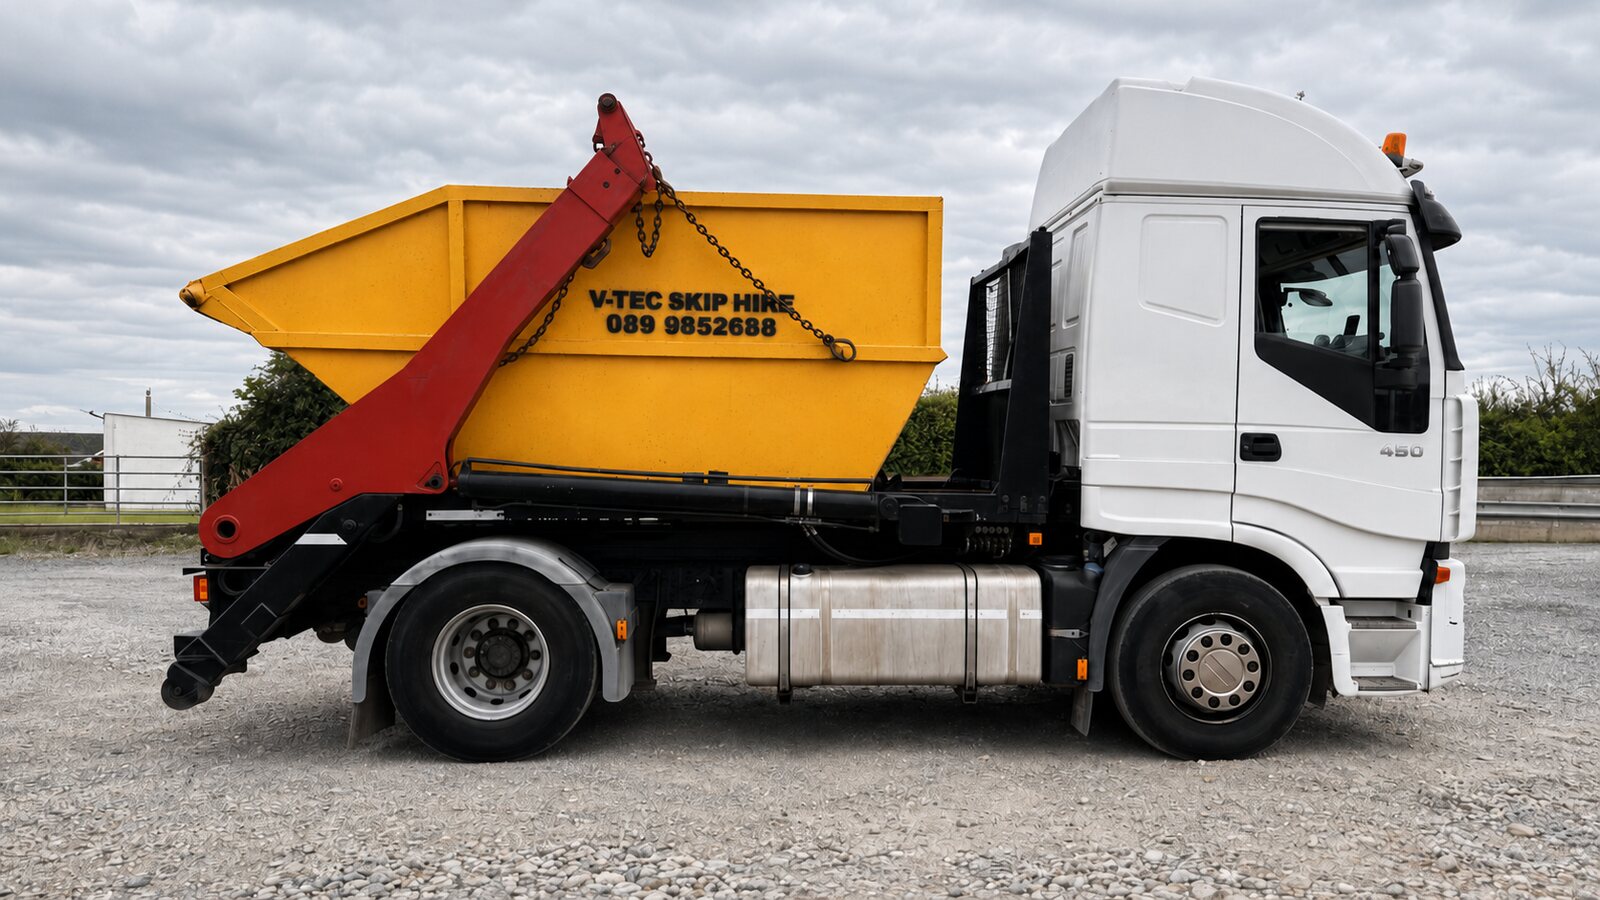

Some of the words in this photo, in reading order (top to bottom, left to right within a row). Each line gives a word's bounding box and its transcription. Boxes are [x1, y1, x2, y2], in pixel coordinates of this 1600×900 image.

[589, 289, 663, 310] V-TEC
[668, 292, 729, 312] SKIP
[733, 293, 795, 314] HIRE
[606, 314, 655, 334] 089
[664, 316, 777, 337] 9852688
[1380, 444, 1424, 457] 450
